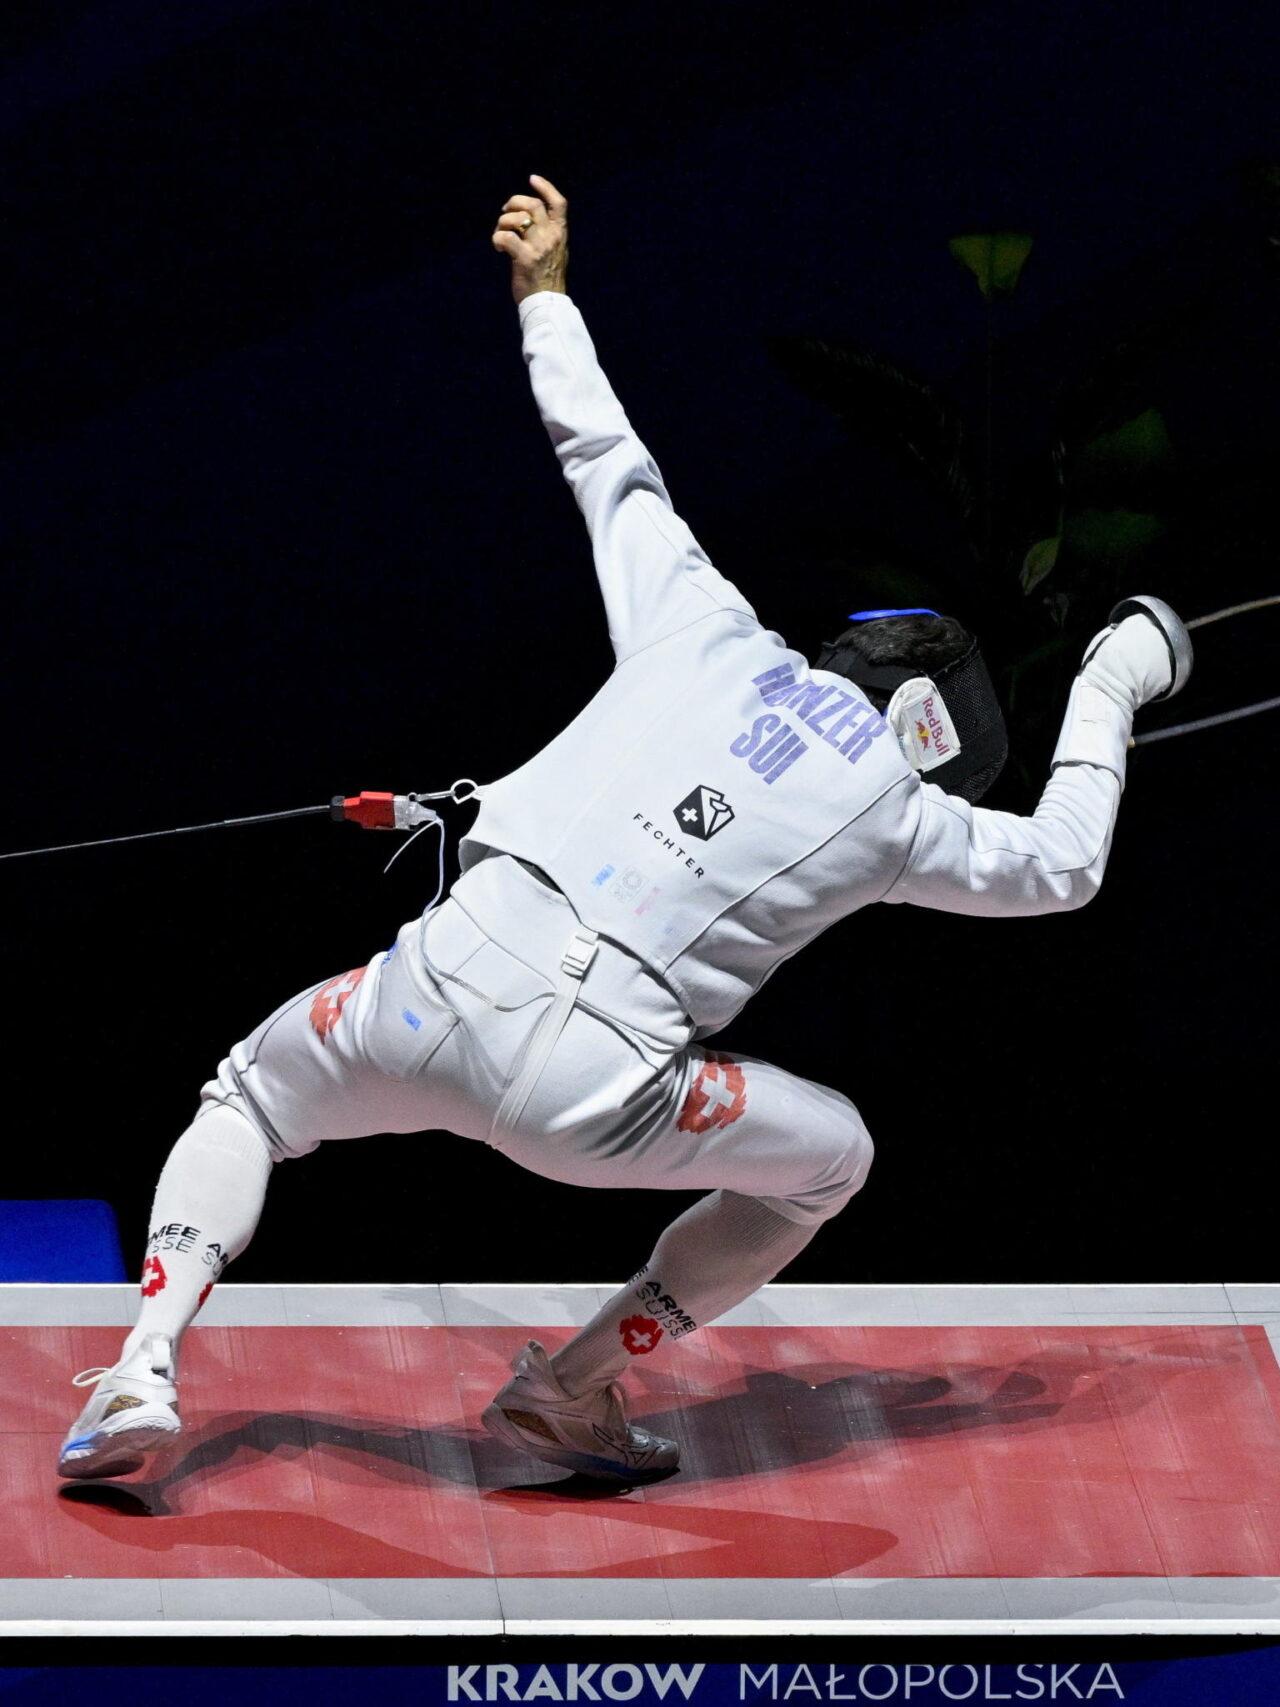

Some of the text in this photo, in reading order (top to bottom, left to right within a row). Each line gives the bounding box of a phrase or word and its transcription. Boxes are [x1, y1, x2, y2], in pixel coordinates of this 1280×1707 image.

[730, 713, 810, 786] SUI
[632, 812, 706, 880] FECHTER
[636, 1287, 684, 1340] SUISS
[447, 1663, 1126, 1701] KRAKOW MAŁOPOLSKA
